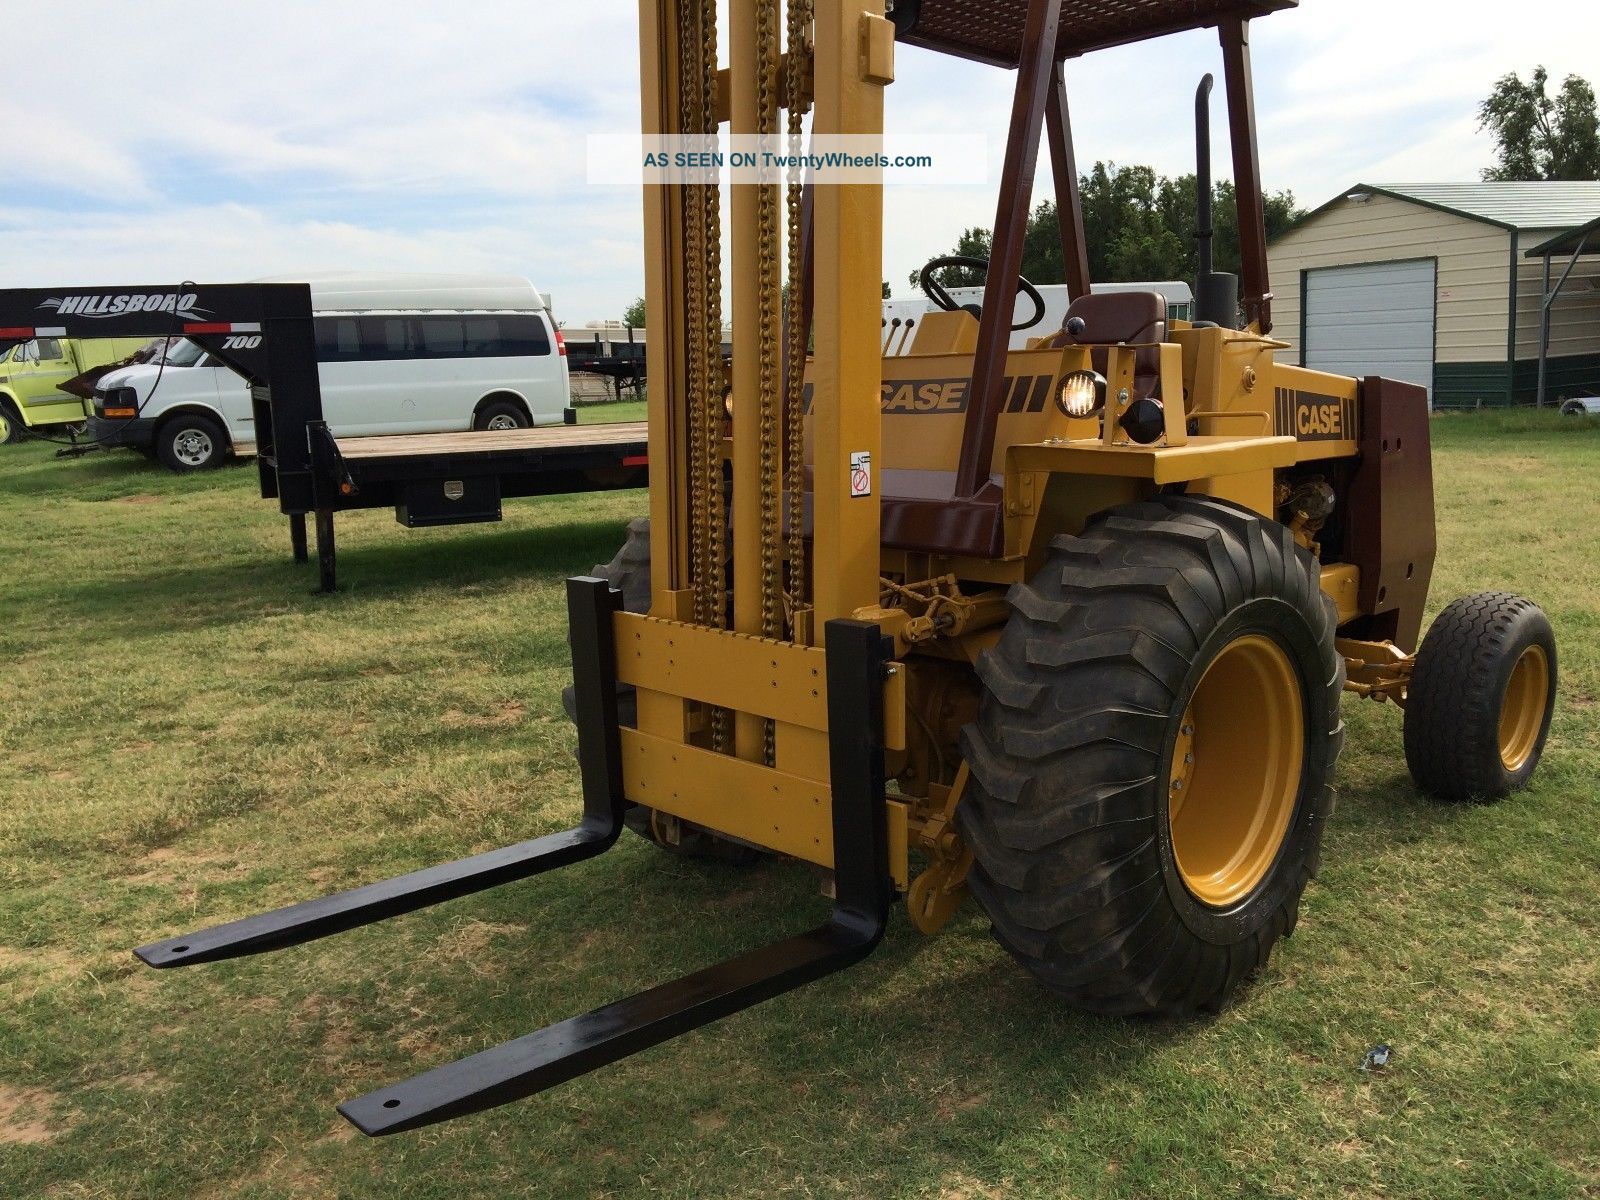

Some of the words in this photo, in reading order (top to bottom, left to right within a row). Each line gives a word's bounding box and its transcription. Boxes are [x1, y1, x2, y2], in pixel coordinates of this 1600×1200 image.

[57, 294, 197, 314] HILLSBORO
[221, 335, 262, 350] 700
[1297, 404, 1341, 435] CASE
